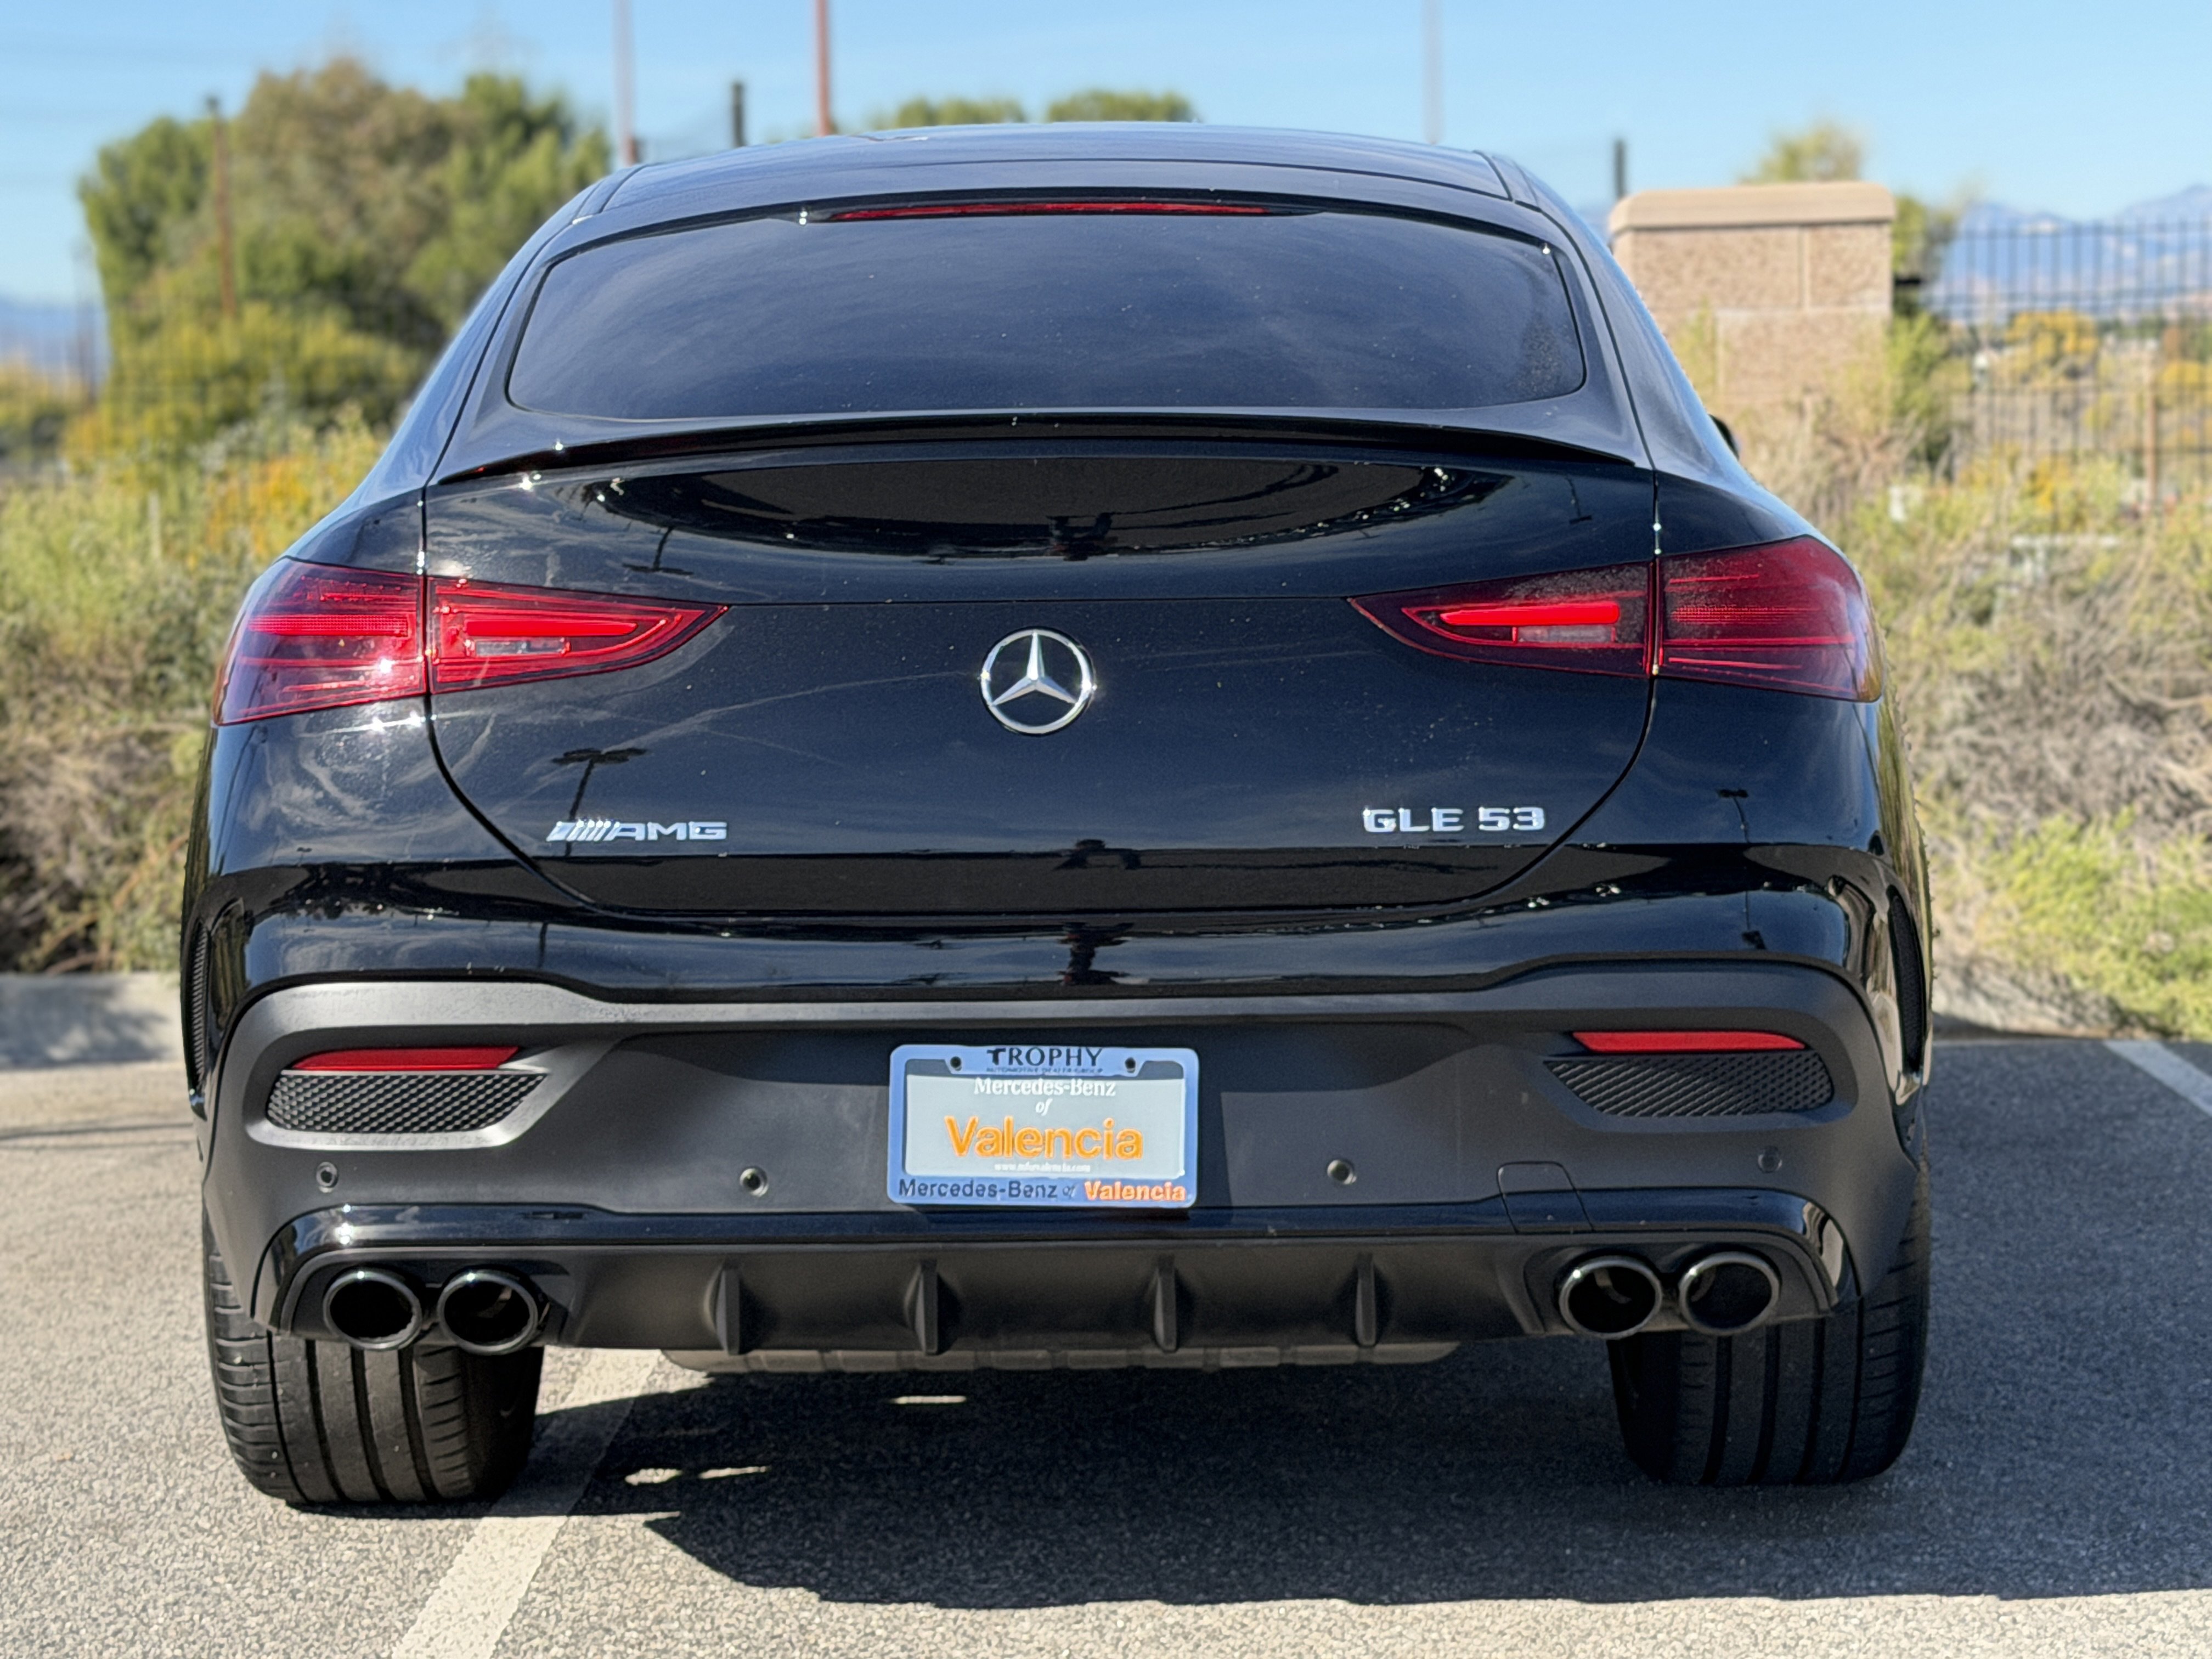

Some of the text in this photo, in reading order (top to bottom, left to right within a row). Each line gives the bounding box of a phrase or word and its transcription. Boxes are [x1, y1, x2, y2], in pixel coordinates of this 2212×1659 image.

[1363, 806, 1545, 833] GLE 53
[986, 1047, 1102, 1066] TROPHY
[974, 1077, 1116, 1097] Mercedes-Benz
[1035, 1098, 1052, 1116] of
[944, 1115, 1144, 1160] Valencia
[899, 1178, 1057, 1198] Mercedes-Benz
[1084, 1181, 1186, 1201] Valencia
